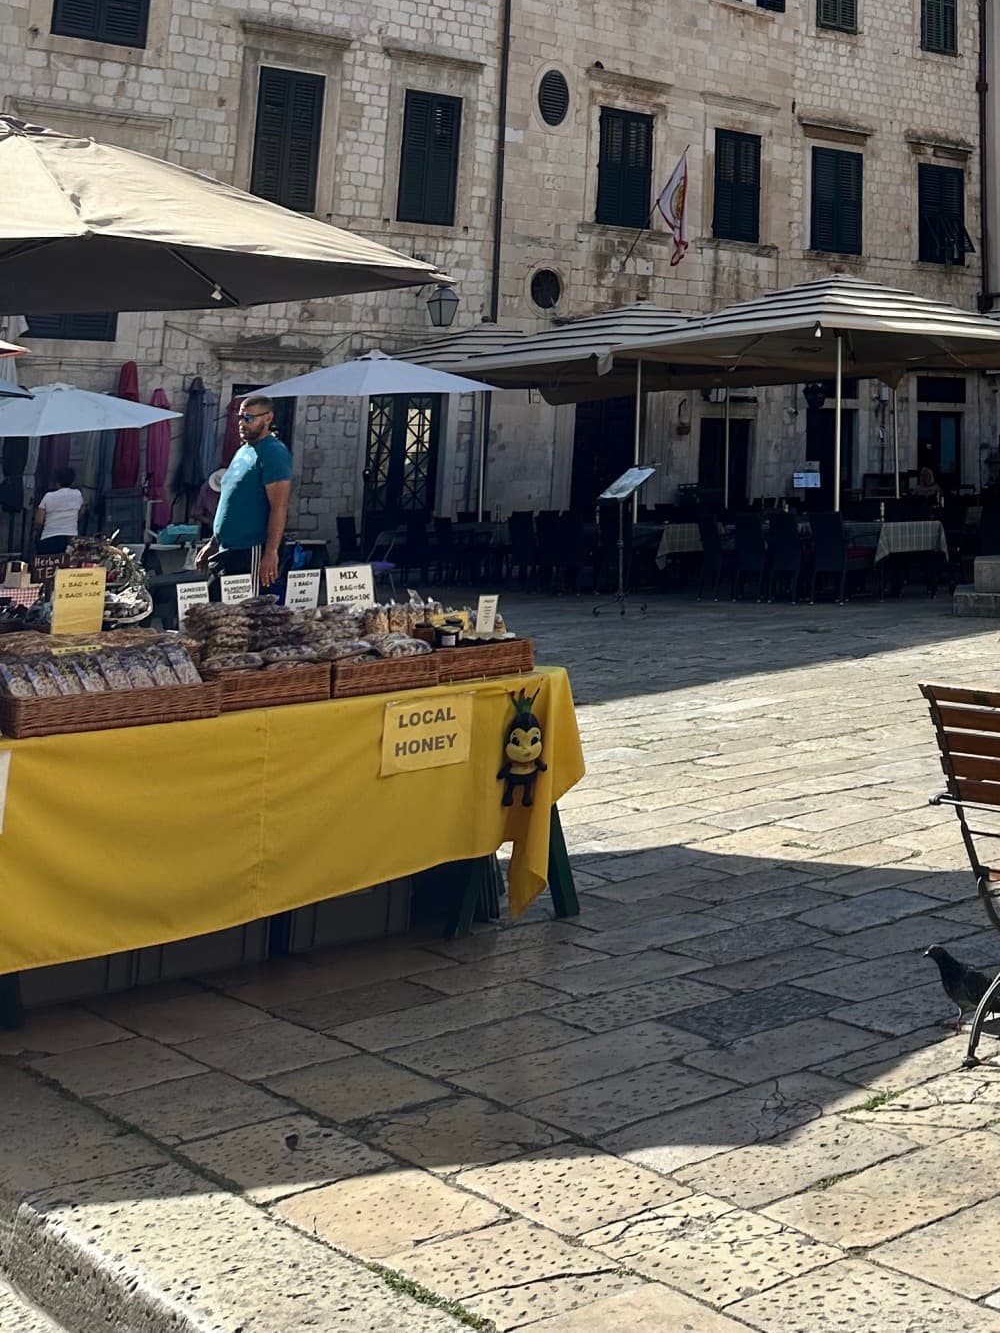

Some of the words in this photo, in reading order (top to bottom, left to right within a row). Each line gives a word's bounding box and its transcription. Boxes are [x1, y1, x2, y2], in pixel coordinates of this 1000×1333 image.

[34, 554, 65, 568] Herbal
[339, 571, 359, 580] MIX
[398, 707, 456, 729] LOCAL
[395, 732, 458, 757] HONEY
